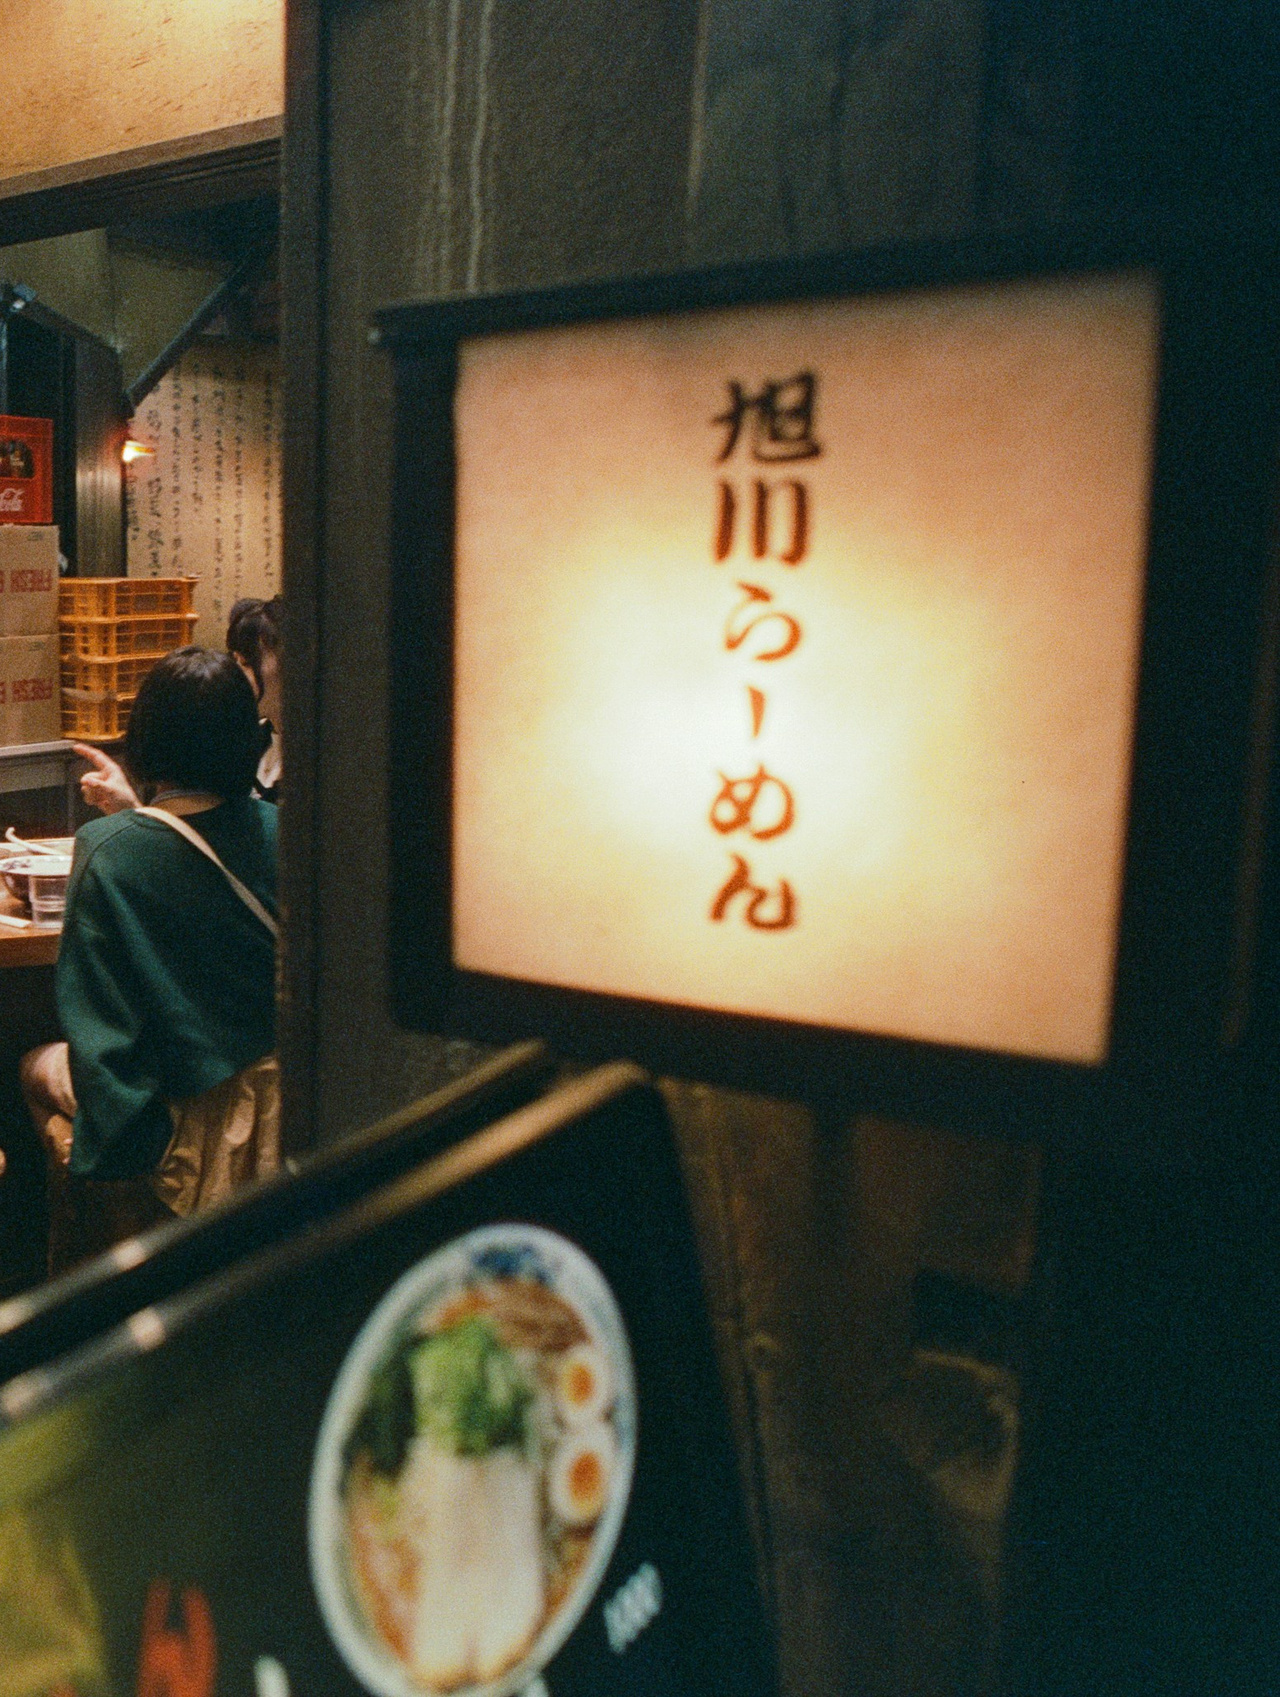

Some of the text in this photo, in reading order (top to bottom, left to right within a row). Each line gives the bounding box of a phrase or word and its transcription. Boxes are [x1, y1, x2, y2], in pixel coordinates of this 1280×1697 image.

[9, 568, 53, 593] FRESH
[709, 368, 825, 933] 旭川らーめん
[11, 677, 54, 703] FRESH
